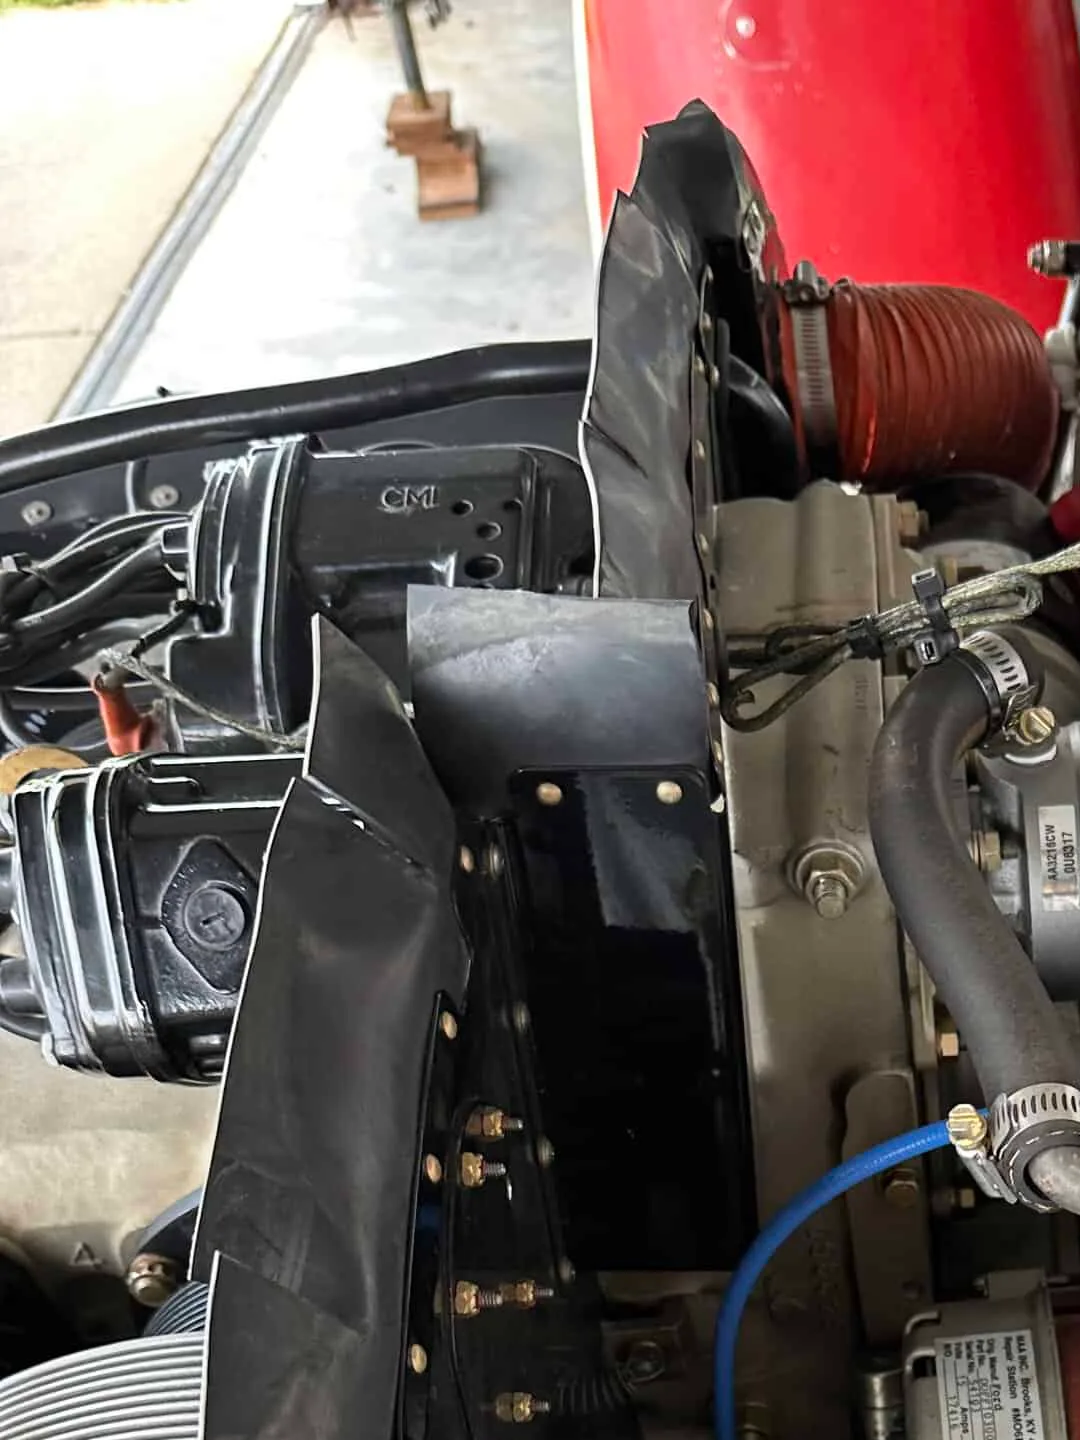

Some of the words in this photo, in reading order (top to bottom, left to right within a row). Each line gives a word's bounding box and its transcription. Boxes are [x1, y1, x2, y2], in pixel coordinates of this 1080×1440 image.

[1007, 1366, 1018, 1399] Station
[992, 1384, 1004, 1411] Ford
[1021, 1378, 1033, 1416] Brooks,
[960, 1407, 969, 1435] Amps
[1025, 1418, 1036, 1434] KY
